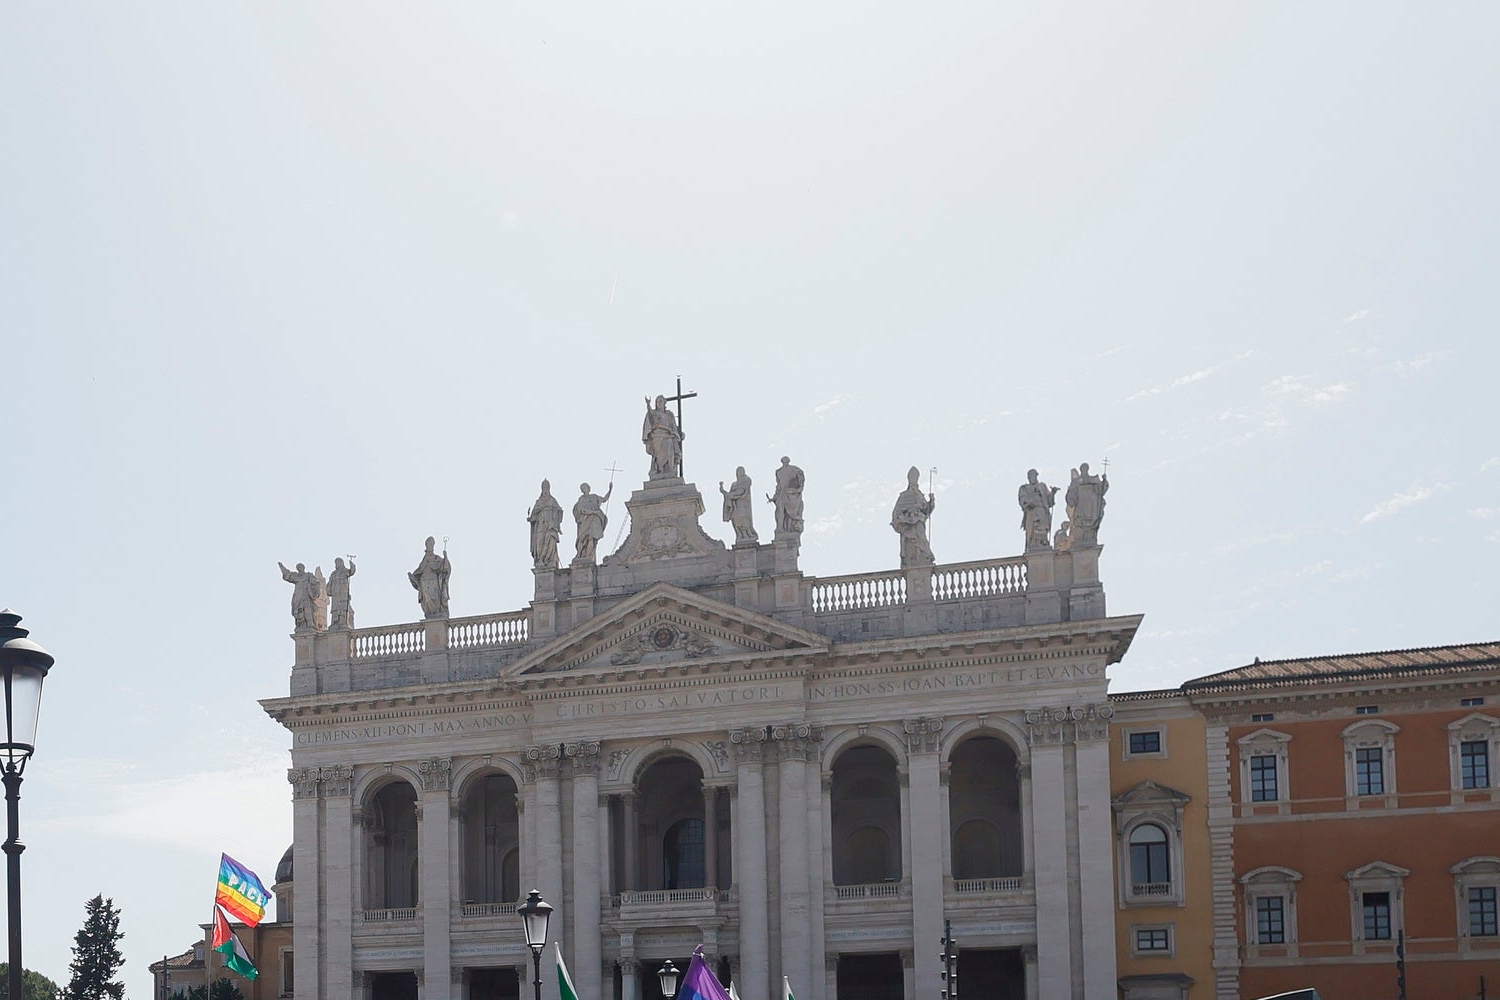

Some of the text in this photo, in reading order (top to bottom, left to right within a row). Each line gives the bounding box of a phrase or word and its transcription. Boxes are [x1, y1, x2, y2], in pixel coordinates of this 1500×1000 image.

[556, 686, 782, 718] CHRISTO SALVATORI
[297, 728, 358, 746] CLEMENS
